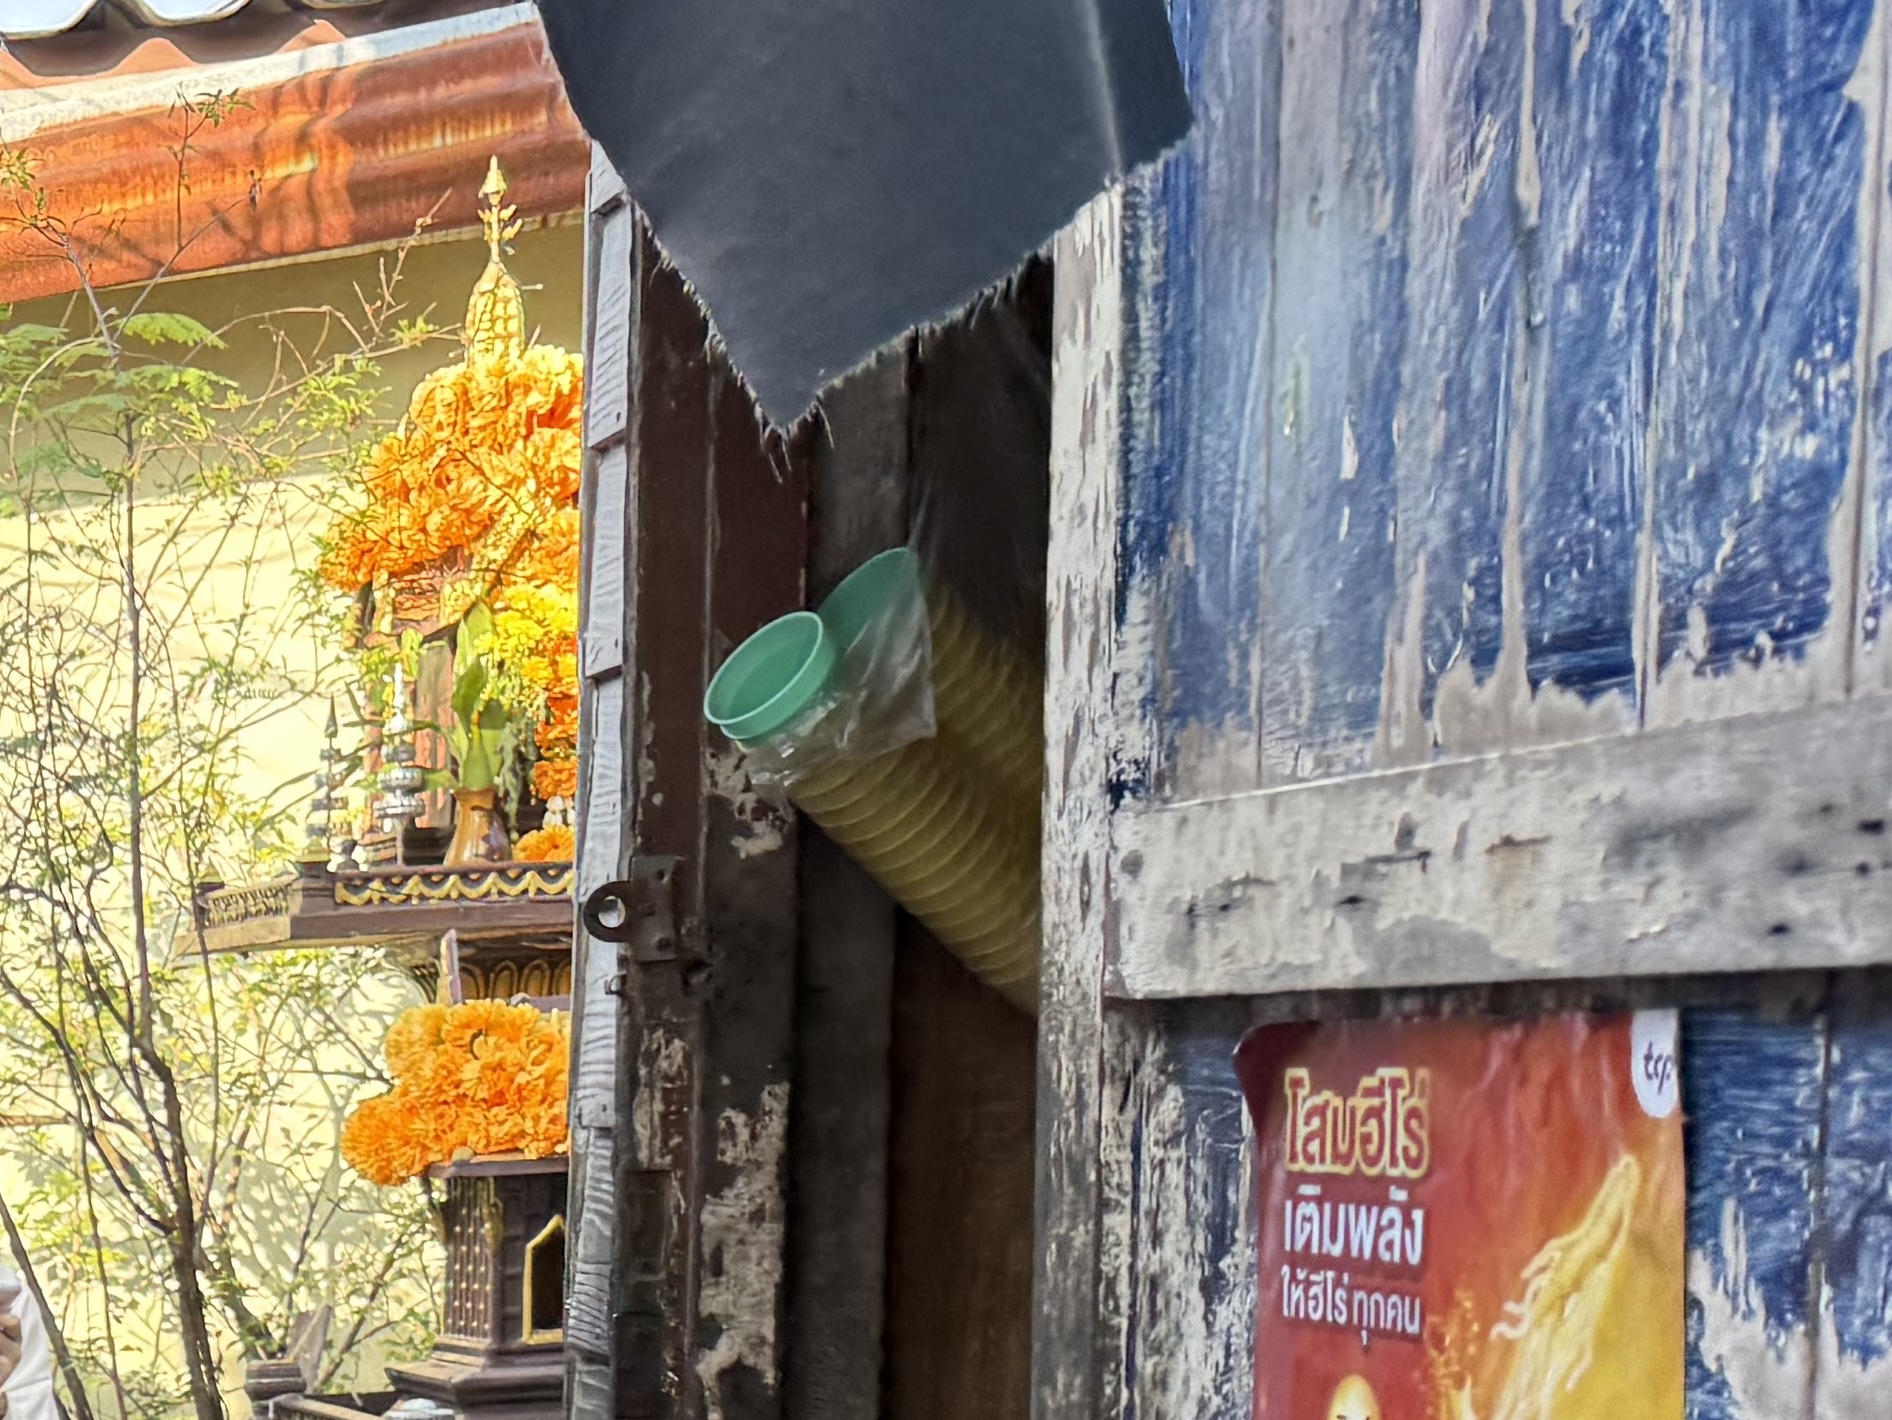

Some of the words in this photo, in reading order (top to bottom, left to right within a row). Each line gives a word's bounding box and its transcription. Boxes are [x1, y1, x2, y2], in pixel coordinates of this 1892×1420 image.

[1283, 1184, 1425, 1265] เติมพลัง
[1281, 1264, 1349, 1325] ให้ฮีโร่
[1353, 1289, 1421, 1346] ทุกคน
